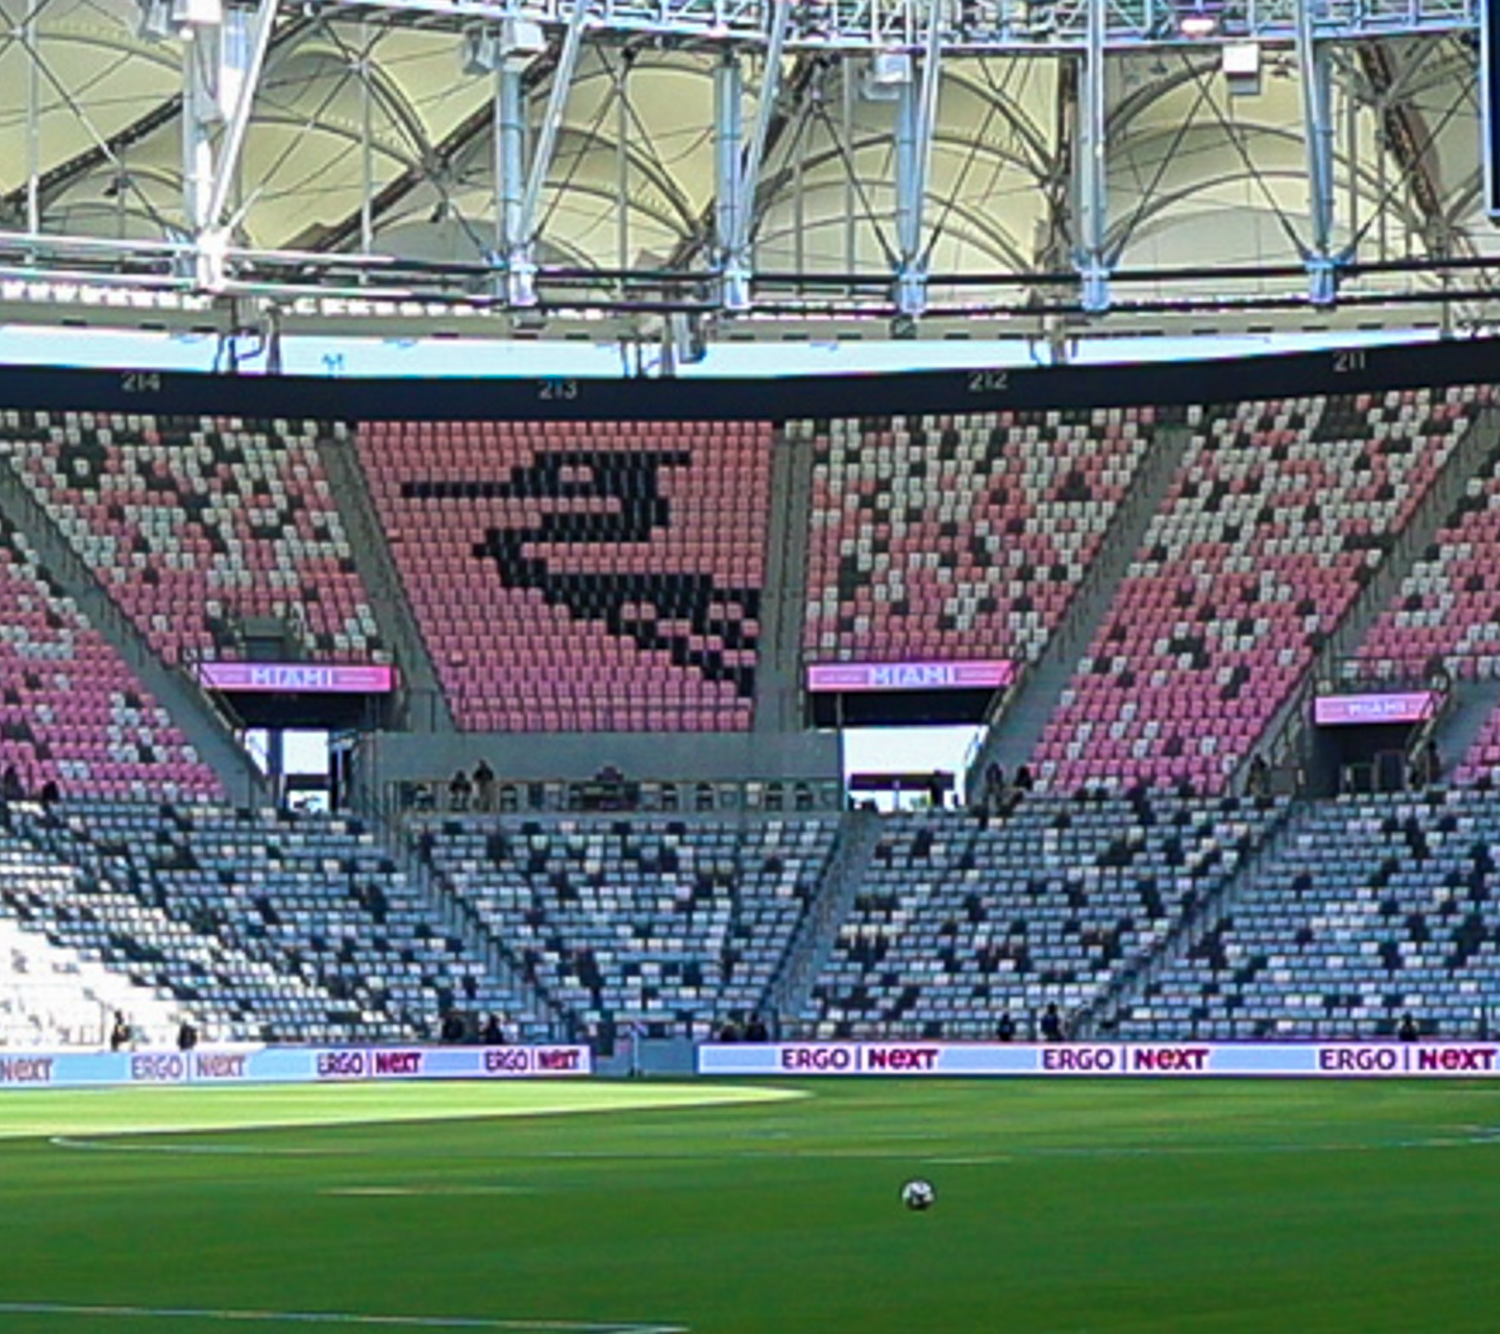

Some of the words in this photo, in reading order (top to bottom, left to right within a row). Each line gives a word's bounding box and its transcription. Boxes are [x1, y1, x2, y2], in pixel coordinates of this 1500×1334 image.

[1333, 349, 1367, 371] 211
[123, 372, 160, 392] 214
[539, 381, 577, 399] 213
[968, 371, 1007, 391] 212
[252, 668, 333, 687] MIAMI
[870, 666, 955, 685] MIAMI
[131, 1055, 184, 1079] ERGO
[317, 1051, 363, 1074] ERGO
[485, 1049, 528, 1070] ERGO
[781, 1047, 850, 1069] ERGO
[1043, 1048, 1114, 1071] ERGO
[1319, 1048, 1396, 1071] ERGO
